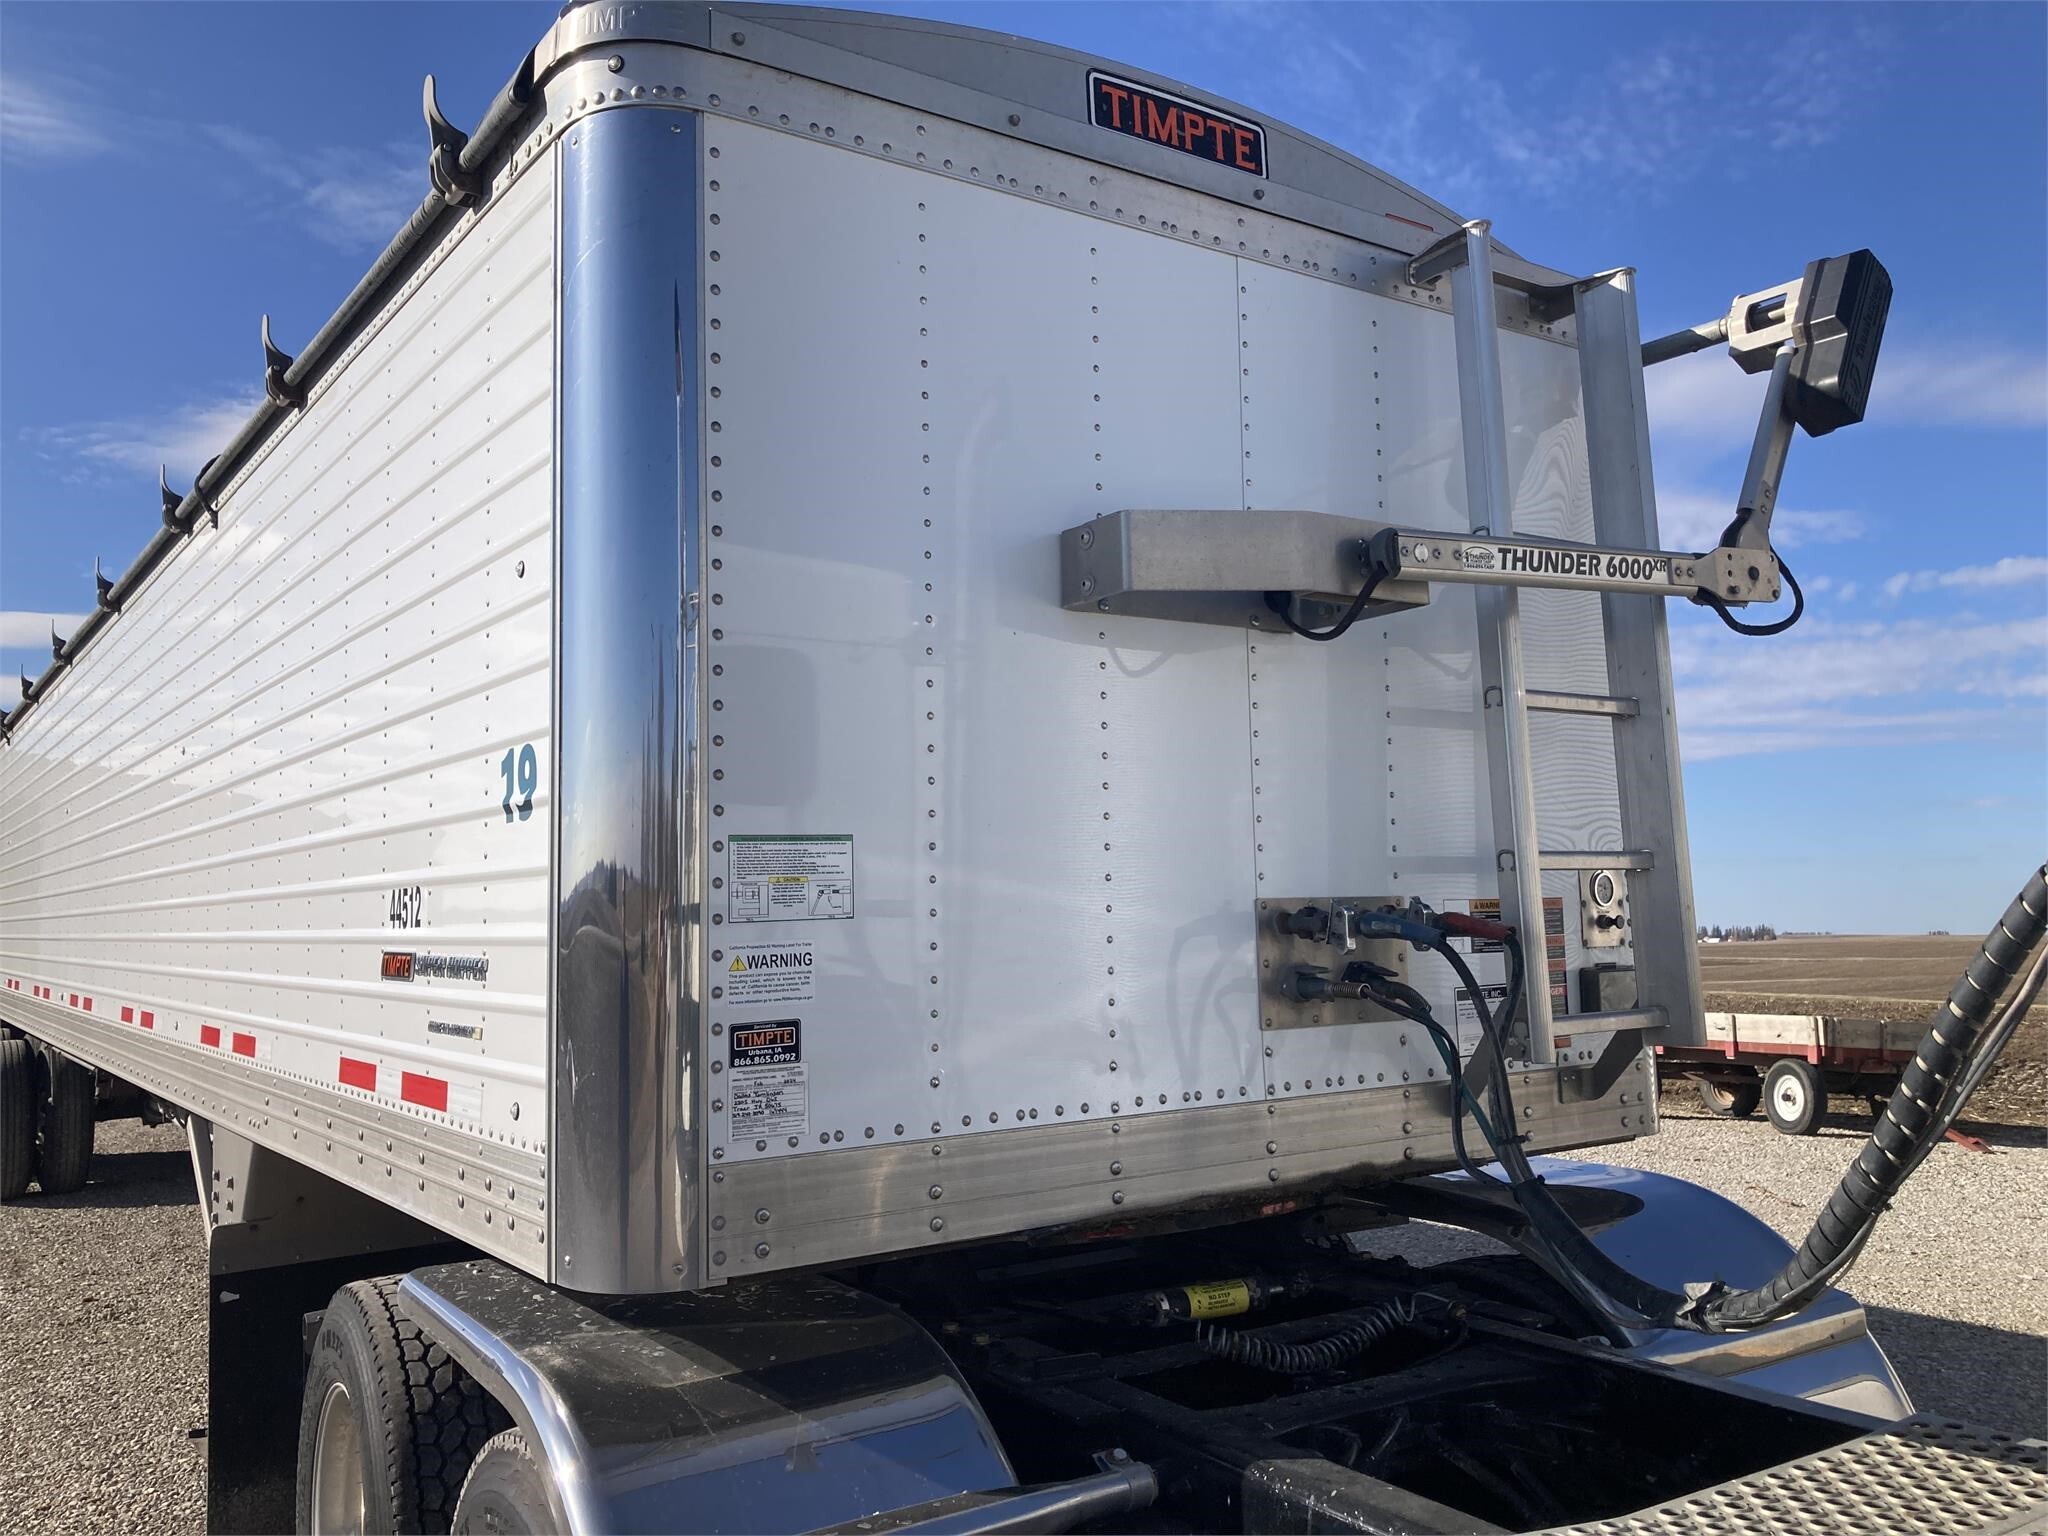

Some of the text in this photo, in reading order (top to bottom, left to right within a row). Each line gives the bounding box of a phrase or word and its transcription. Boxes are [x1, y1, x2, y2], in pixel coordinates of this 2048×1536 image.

[1100, 83, 1256, 171] TIMPTE
[1498, 547, 1600, 577] THUNDER
[501, 743, 537, 824] 19
[389, 886, 422, 930] 44512
[1479, 901, 1500, 910] WARNI
[384, 955, 411, 977] TIMPTE
[746, 952, 813, 970] WARNING
[738, 1030, 792, 1047] TIMPTE
[733, 1052, 796, 1067] 866.865.0992
